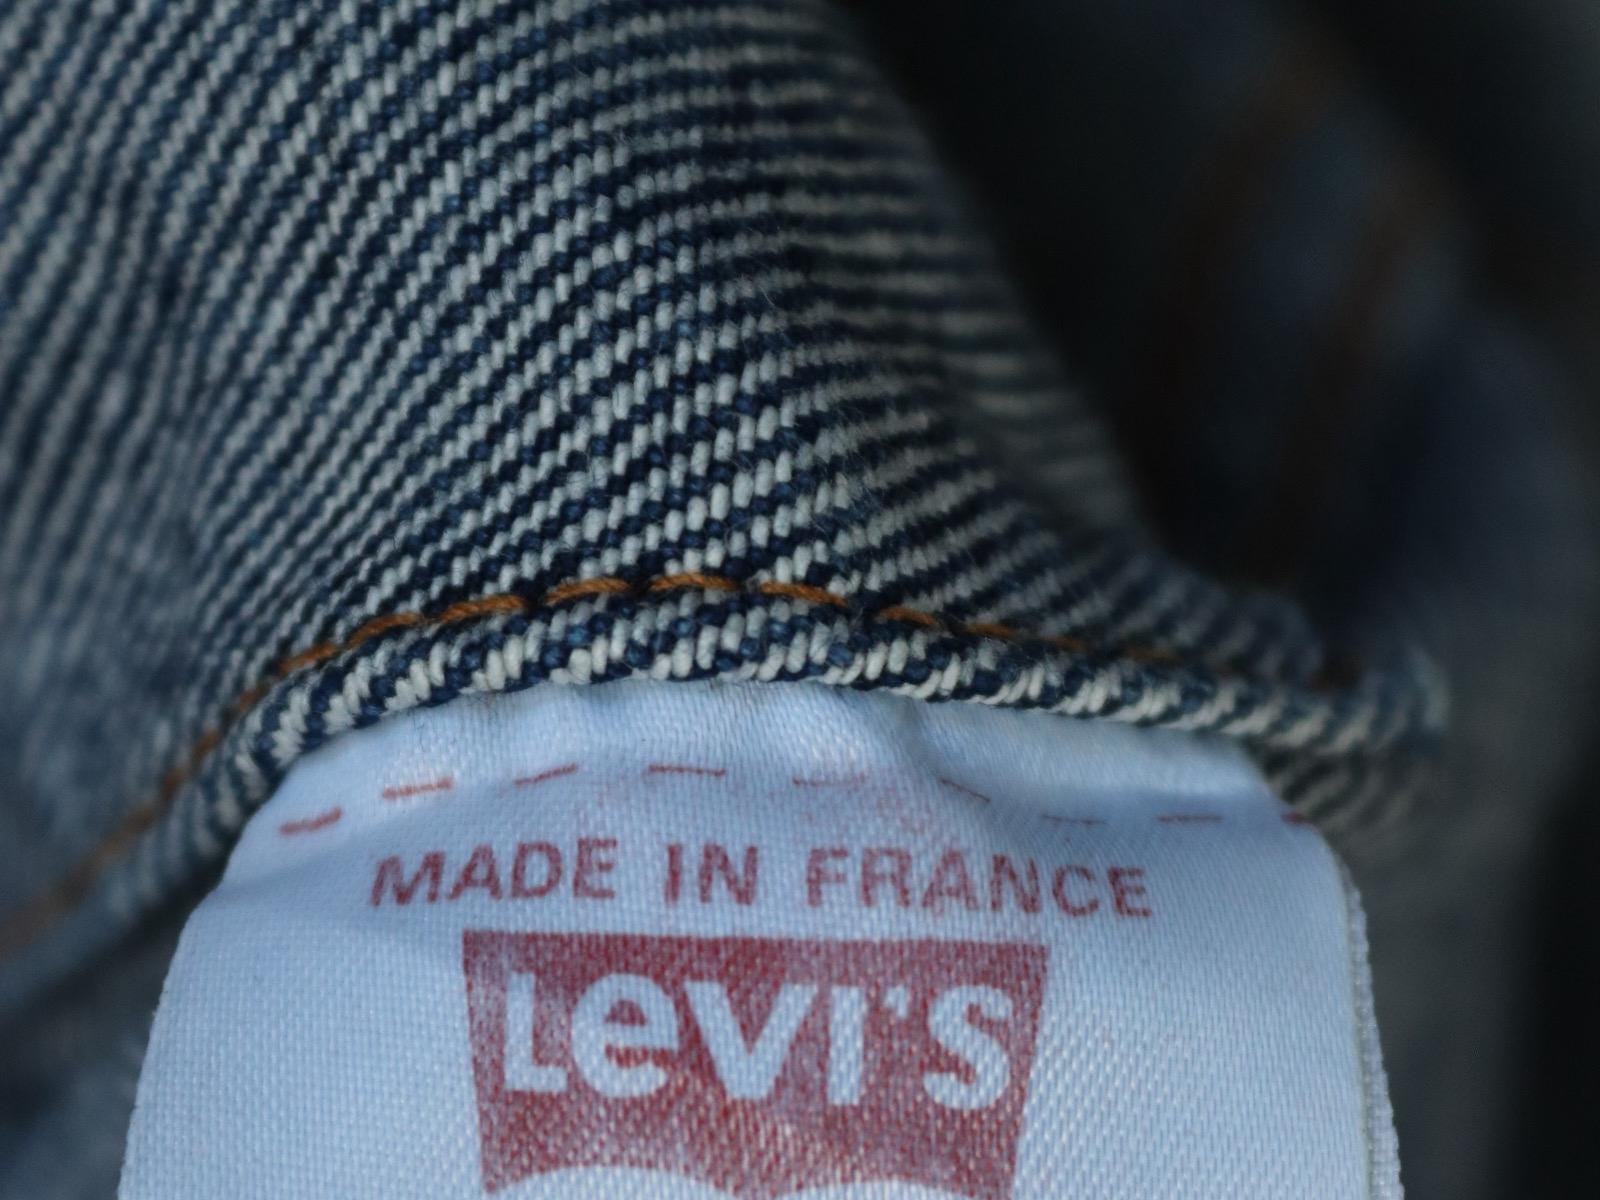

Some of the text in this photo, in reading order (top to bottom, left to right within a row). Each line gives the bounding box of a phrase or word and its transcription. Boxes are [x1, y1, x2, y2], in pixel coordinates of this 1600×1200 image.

[370, 838, 1154, 918] MADE IN FRANCE
